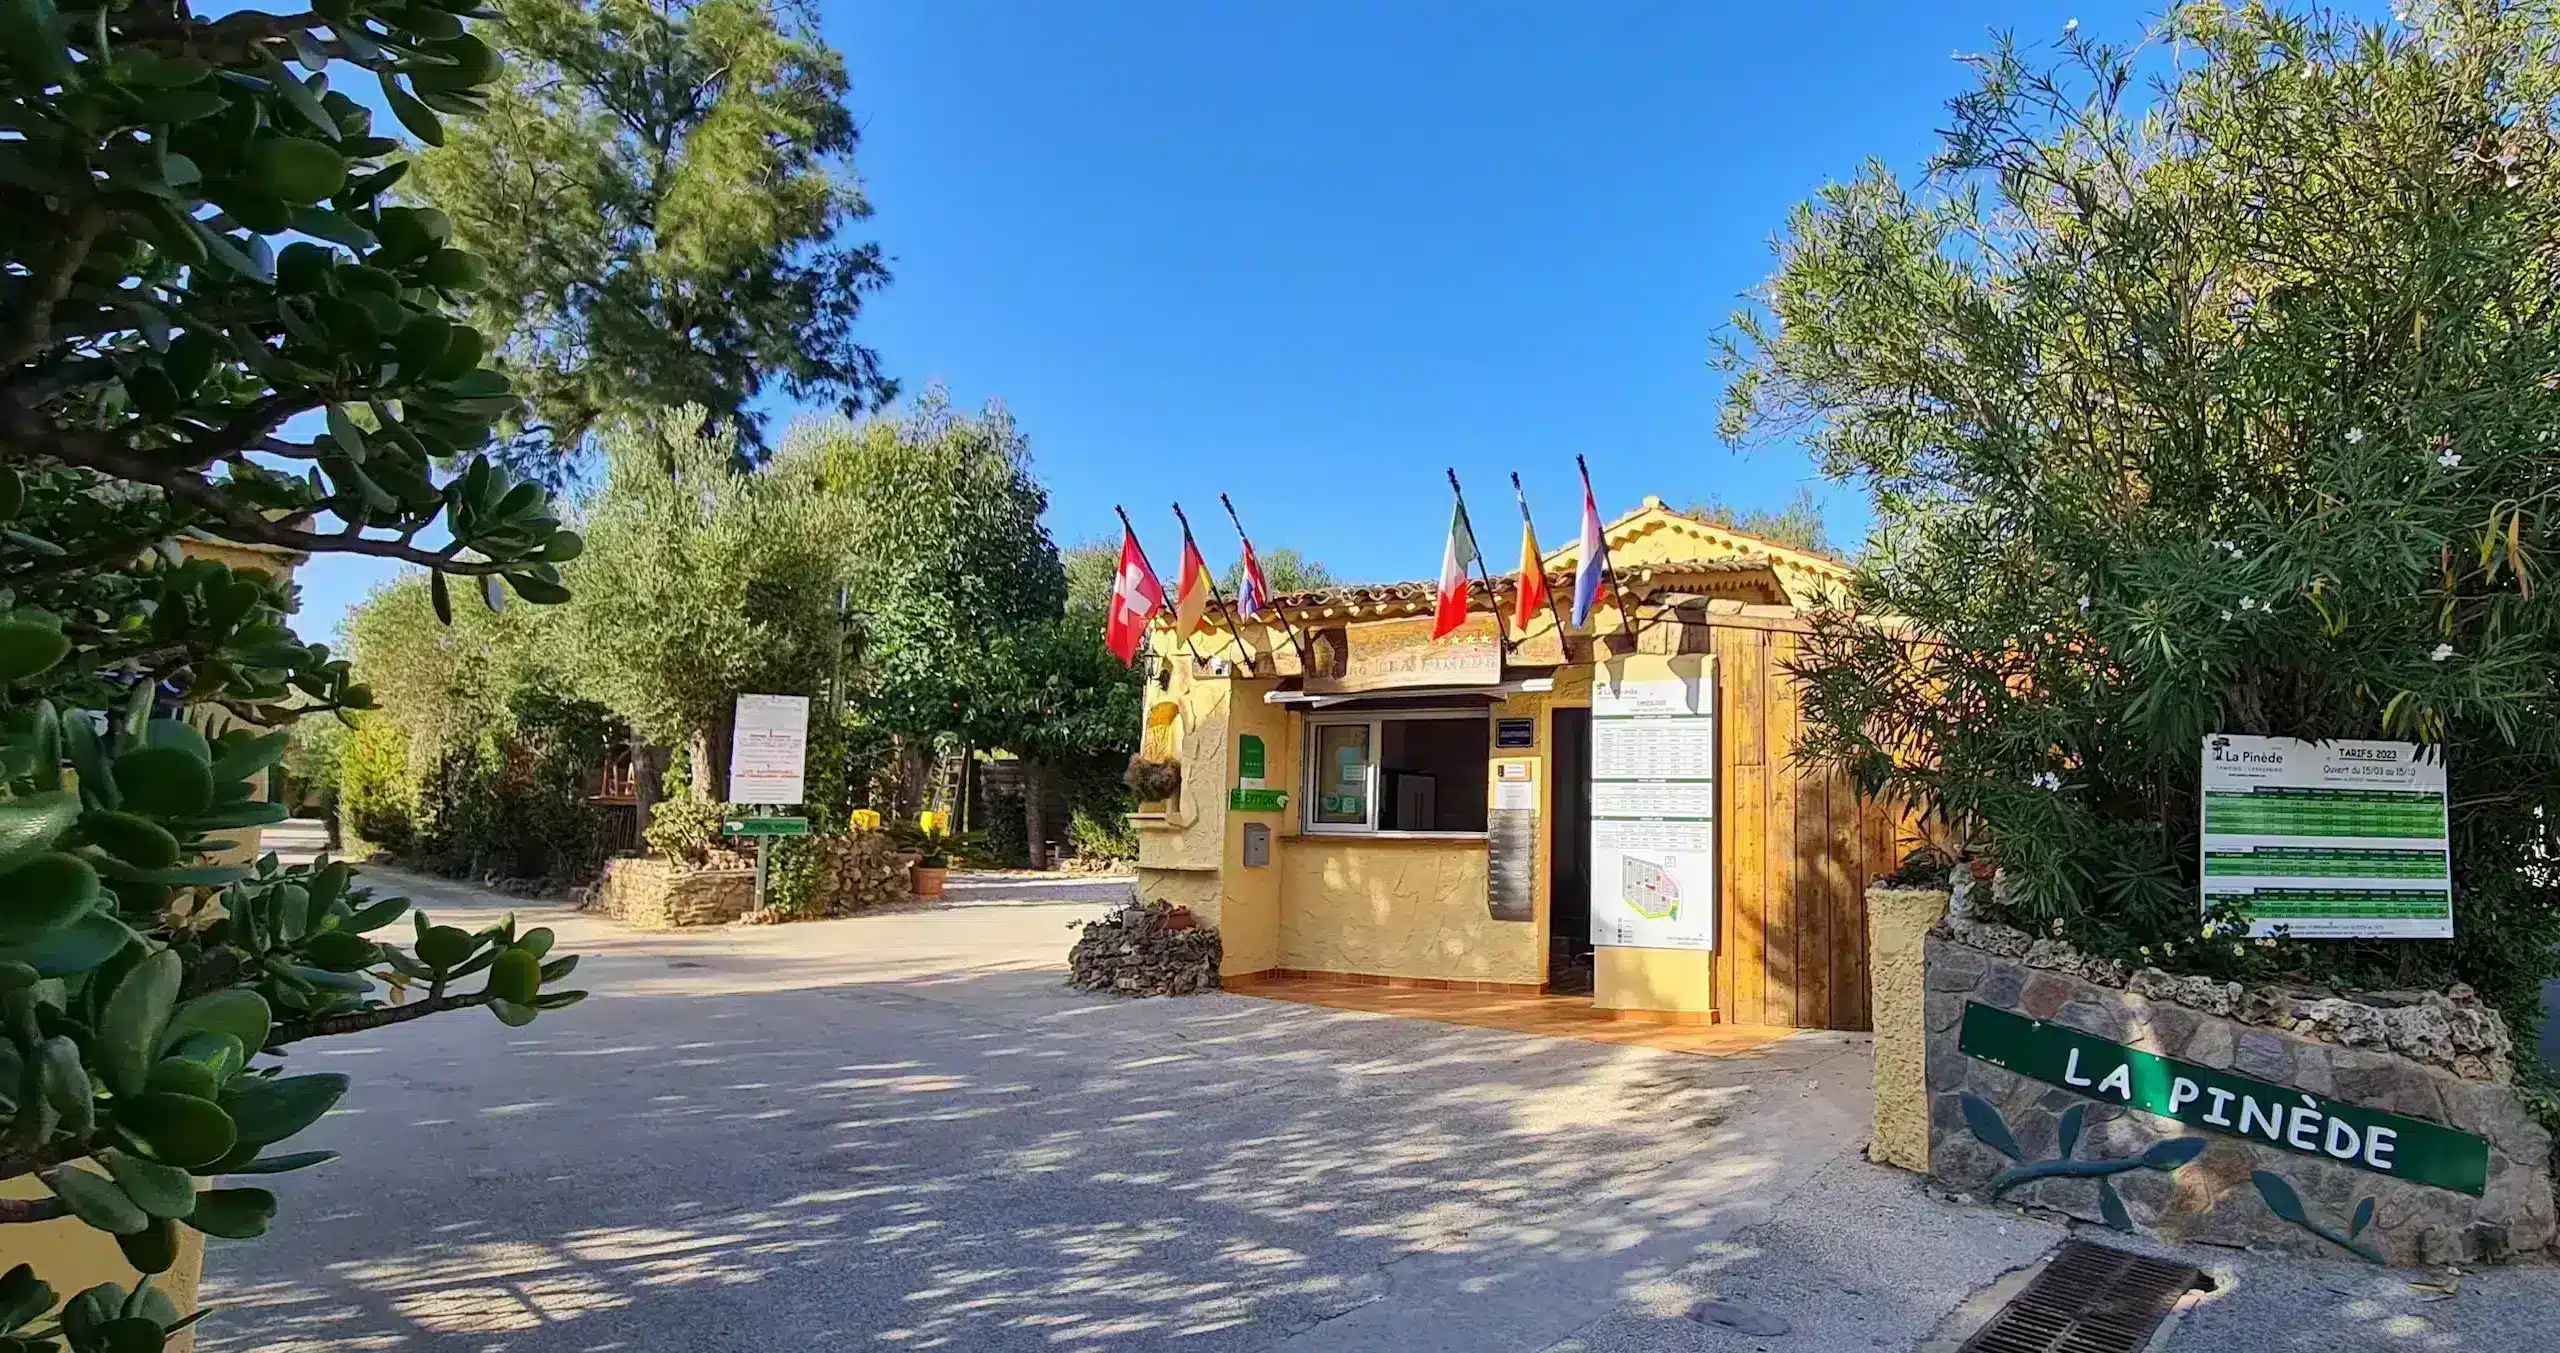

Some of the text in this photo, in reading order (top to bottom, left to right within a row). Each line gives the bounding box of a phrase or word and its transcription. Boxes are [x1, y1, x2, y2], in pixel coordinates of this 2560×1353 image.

[2226, 751, 2284, 764] La Pinède
[2339, 748, 2397, 760] TARIFS 2023
[2324, 765, 2350, 774] Ouvert
[2352, 766, 2361, 775] du
[2064, 1048, 2398, 1170] LA PINÈDE
